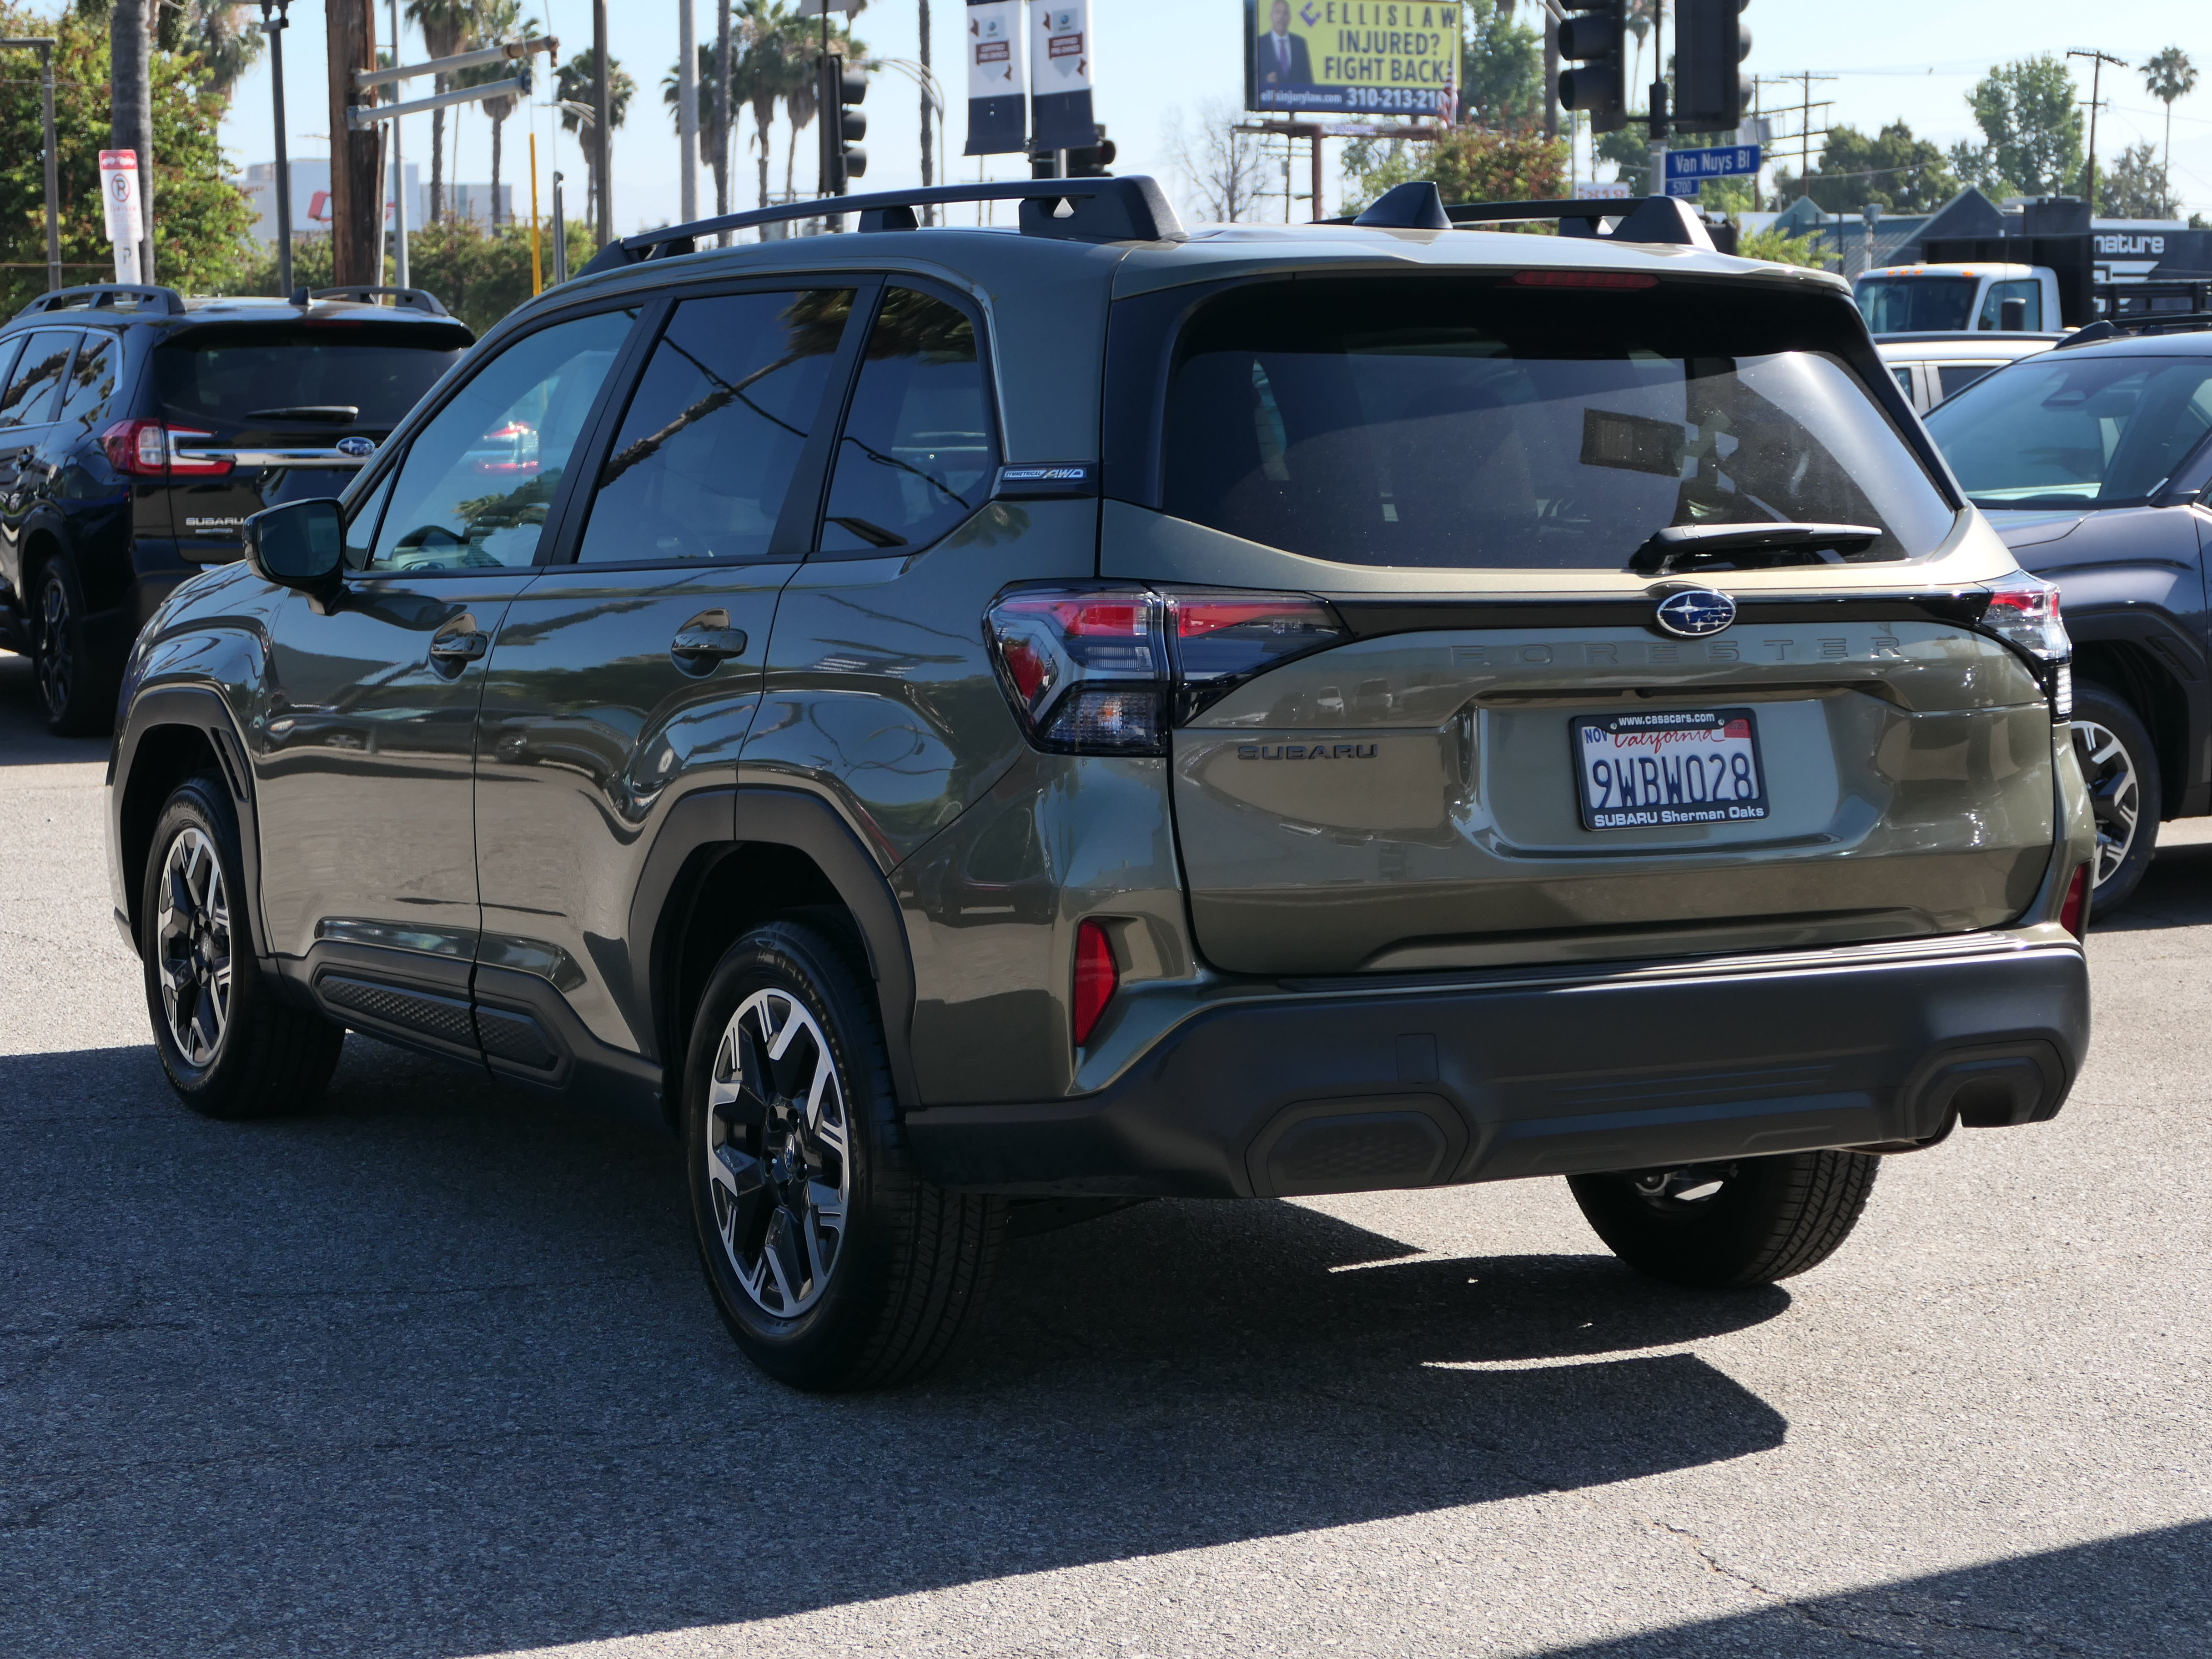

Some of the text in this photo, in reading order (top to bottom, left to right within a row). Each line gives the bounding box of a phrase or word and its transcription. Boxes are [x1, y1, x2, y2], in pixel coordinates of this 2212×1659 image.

[1339, 30, 1441, 55] INJURED?
[1324, 55, 1385, 80] FIGHT
[1260, 90, 1342, 106] ellsinjurylaw.com
[1346, 87, 1447, 109] 310-213-210
[1676, 155, 1697, 173] Van
[1702, 153, 1732, 175] Nuys
[1673, 181, 1692, 195] 5700
[1043, 469, 1084, 478] AWD
[186, 517, 244, 526] SUBARU
[1449, 636, 1901, 668] FORESTER
[1619, 713, 1715, 726] www.casacars.com
[1584, 728, 1608, 744] NOV
[1614, 729, 1726, 754] California
[1238, 744, 1377, 760] SUBARU
[1593, 752, 1755, 809] 9WBW028
[1594, 806, 1765, 827] SUBARU Sherman Oaks
